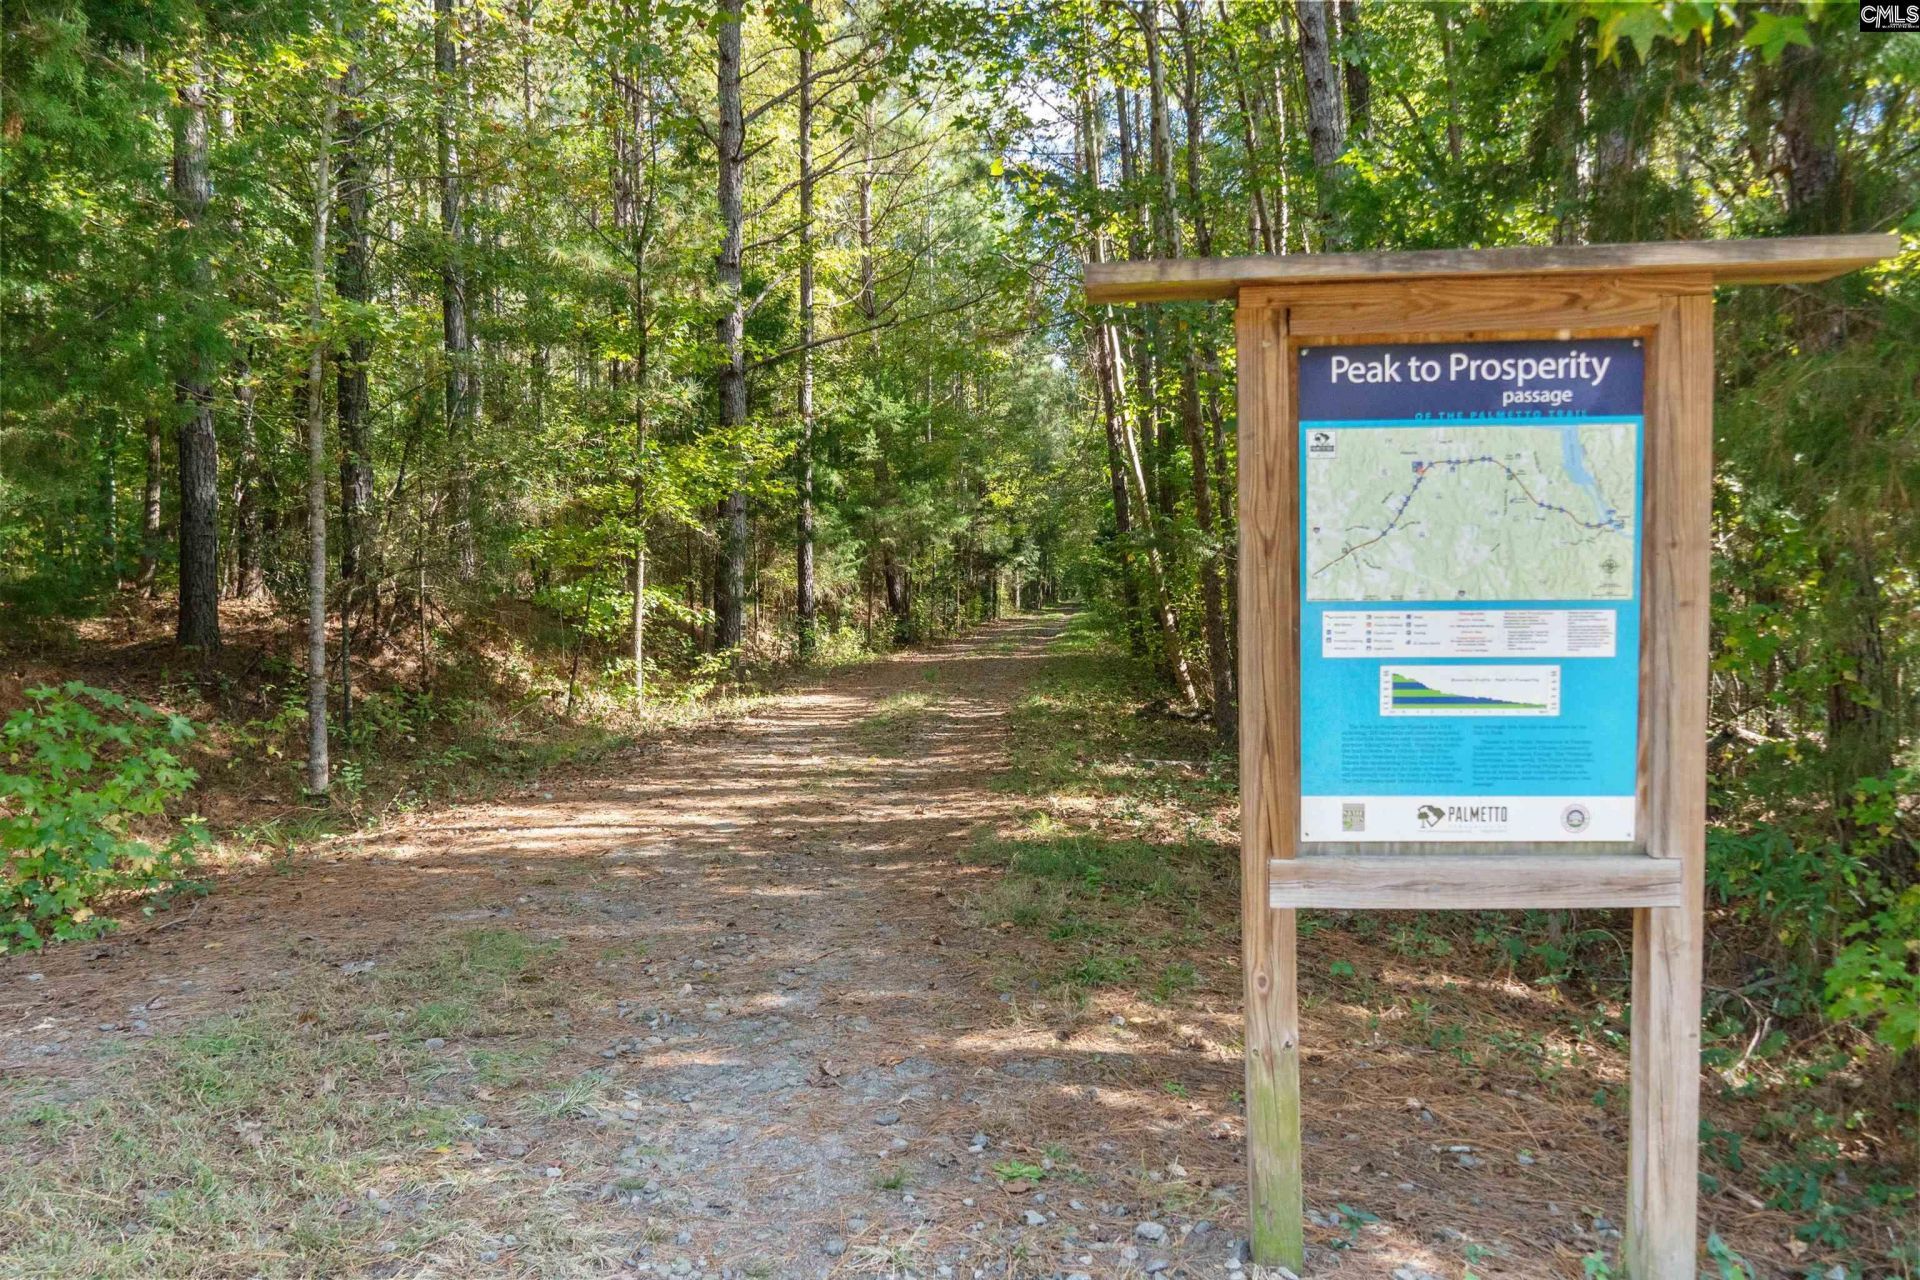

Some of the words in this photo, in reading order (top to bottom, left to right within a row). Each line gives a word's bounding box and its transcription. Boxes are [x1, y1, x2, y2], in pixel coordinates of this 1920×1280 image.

[1331, 353, 1402, 384] Peak
[1407, 356, 1441, 382] to
[1450, 350, 1611, 387] Prosperity
[1502, 389, 1573, 407] passage
[1414, 411, 1432, 420] OF
[1438, 410, 1464, 420] THE
[1469, 409, 1542, 419] PALMETTO
[1448, 806, 1508, 822] PALMETTO
